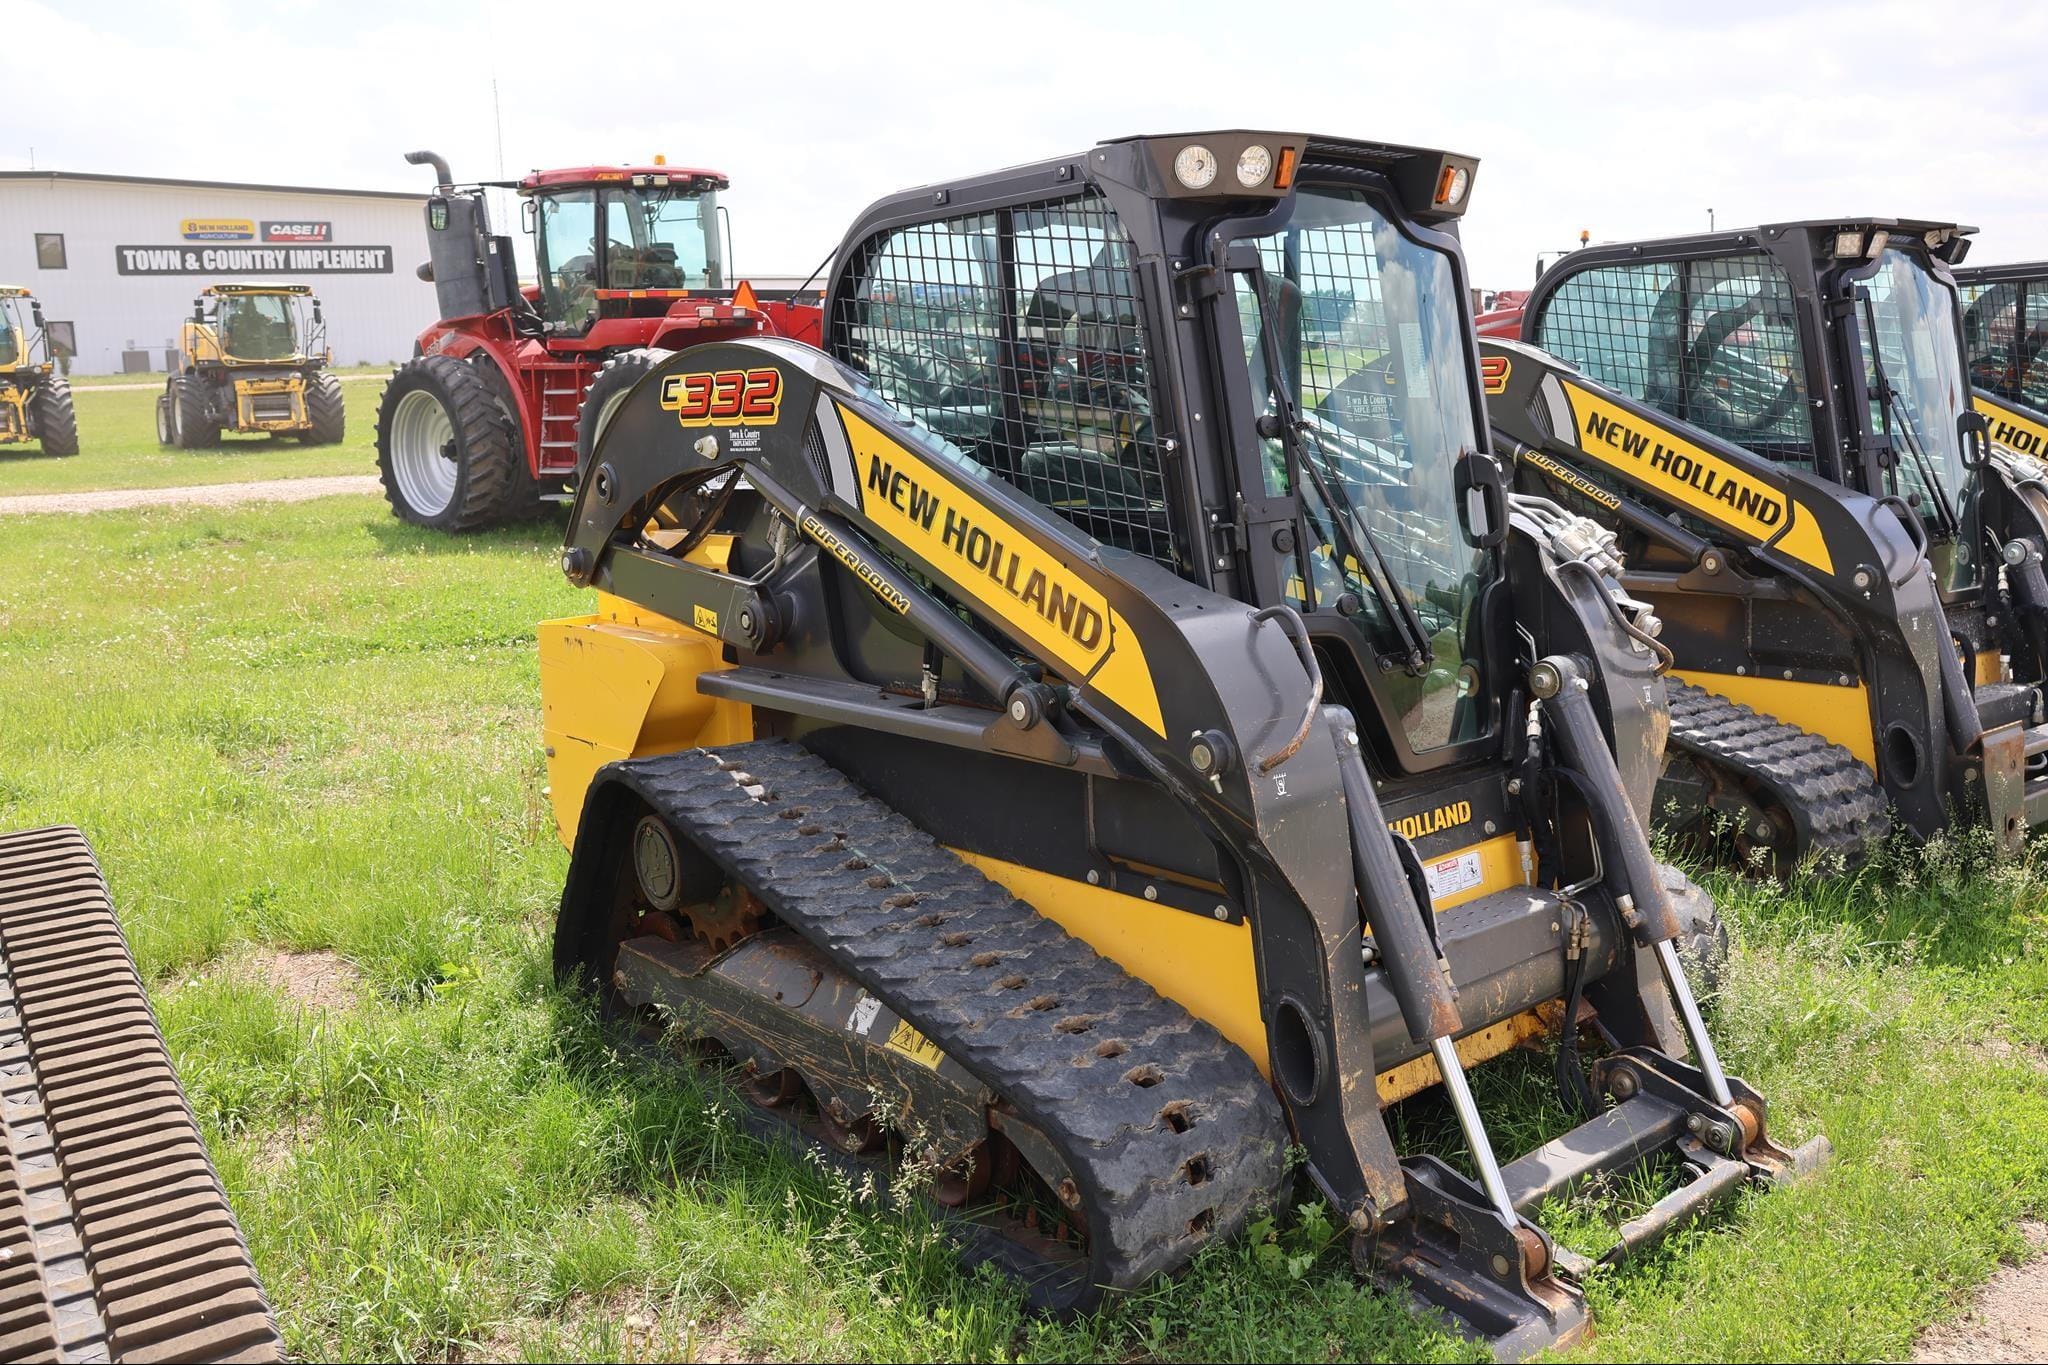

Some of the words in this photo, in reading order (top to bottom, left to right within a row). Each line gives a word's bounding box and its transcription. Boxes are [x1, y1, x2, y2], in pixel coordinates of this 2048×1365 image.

[123, 249, 182, 270] TOWN
[185, 253, 200, 270] &
[202, 249, 286, 270] COUNTRY
[289, 249, 386, 269] IMPLEMENT
[270, 224, 312, 235] CASE
[1525, 449, 1577, 485] SUPER
[1574, 477, 1622, 511] BOOM
[1586, 412, 1650, 459] NEW
[1650, 444, 1781, 526] HOLLAND
[803, 516, 860, 572] SUPER
[857, 562, 911, 615] BOOM
[868, 454, 940, 532] NEW
[942, 507, 1103, 651] HOLLAND
